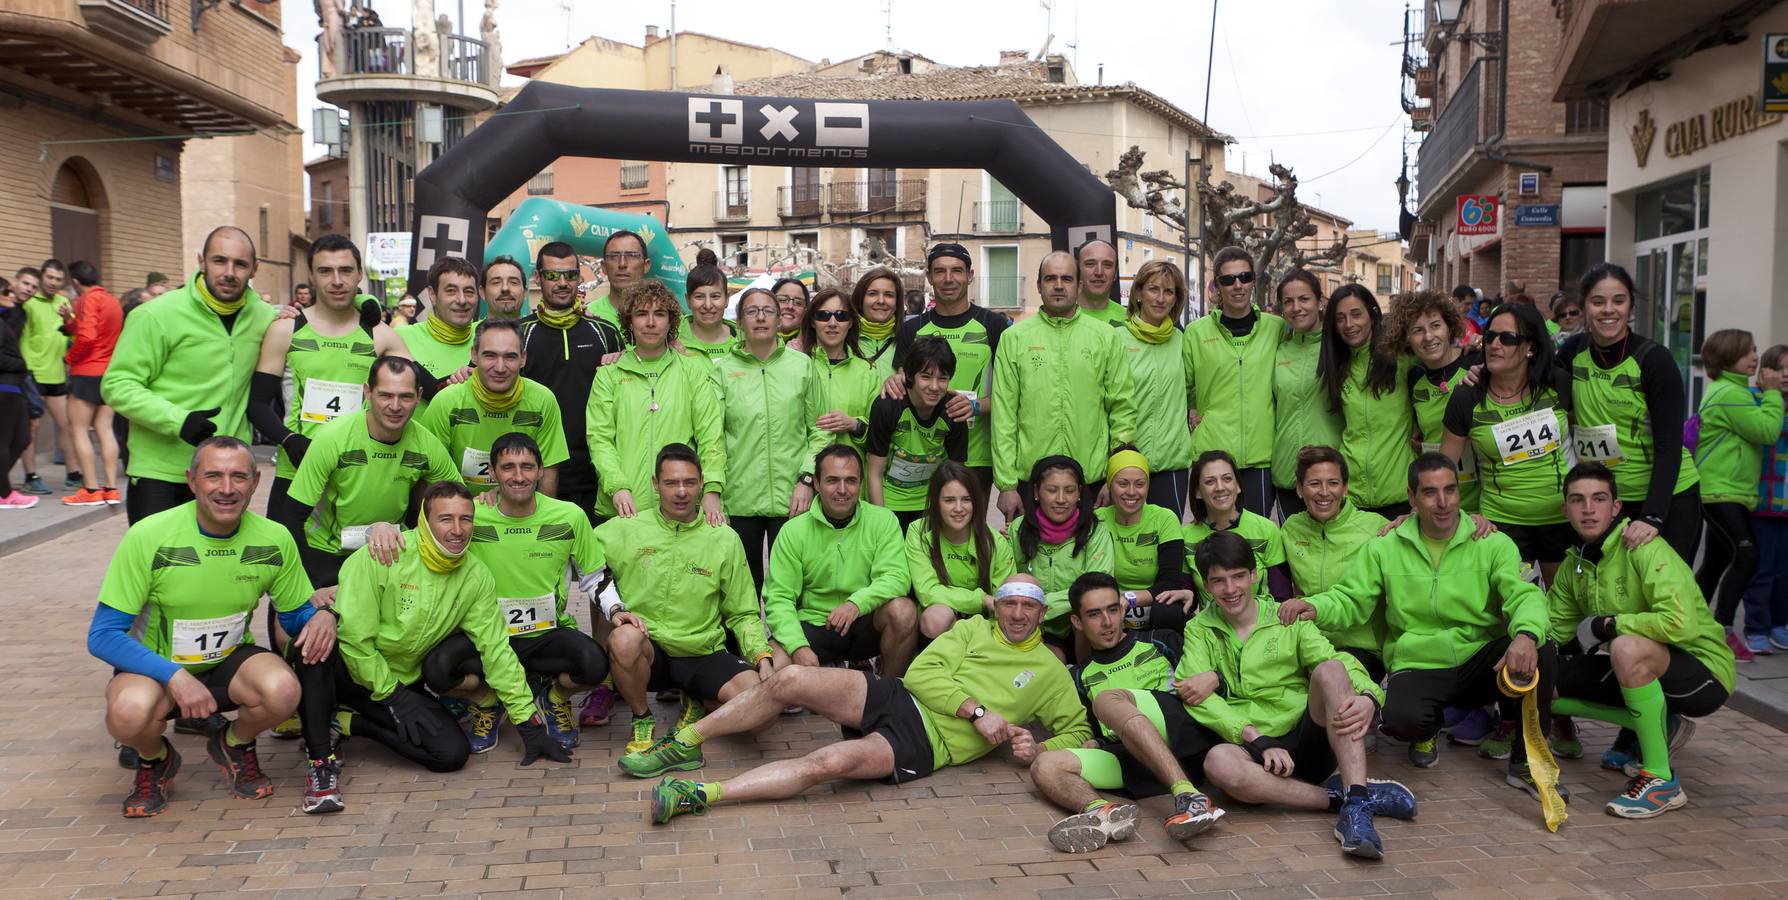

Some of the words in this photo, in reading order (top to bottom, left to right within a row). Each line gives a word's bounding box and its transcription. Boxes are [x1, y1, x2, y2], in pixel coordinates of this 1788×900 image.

[1664, 113, 1709, 159] CAJA
[689, 143, 868, 159] maspormenos
[590, 224, 609, 237] CAJA
[1459, 225, 1477, 233] EURO
[1478, 225, 1497, 233] 6000
[326, 395, 341, 413] 4
[1506, 423, 1553, 453] 214
[1577, 439, 1611, 458] 211
[508, 607, 537, 625] 21
[194, 630, 230, 651] 17
